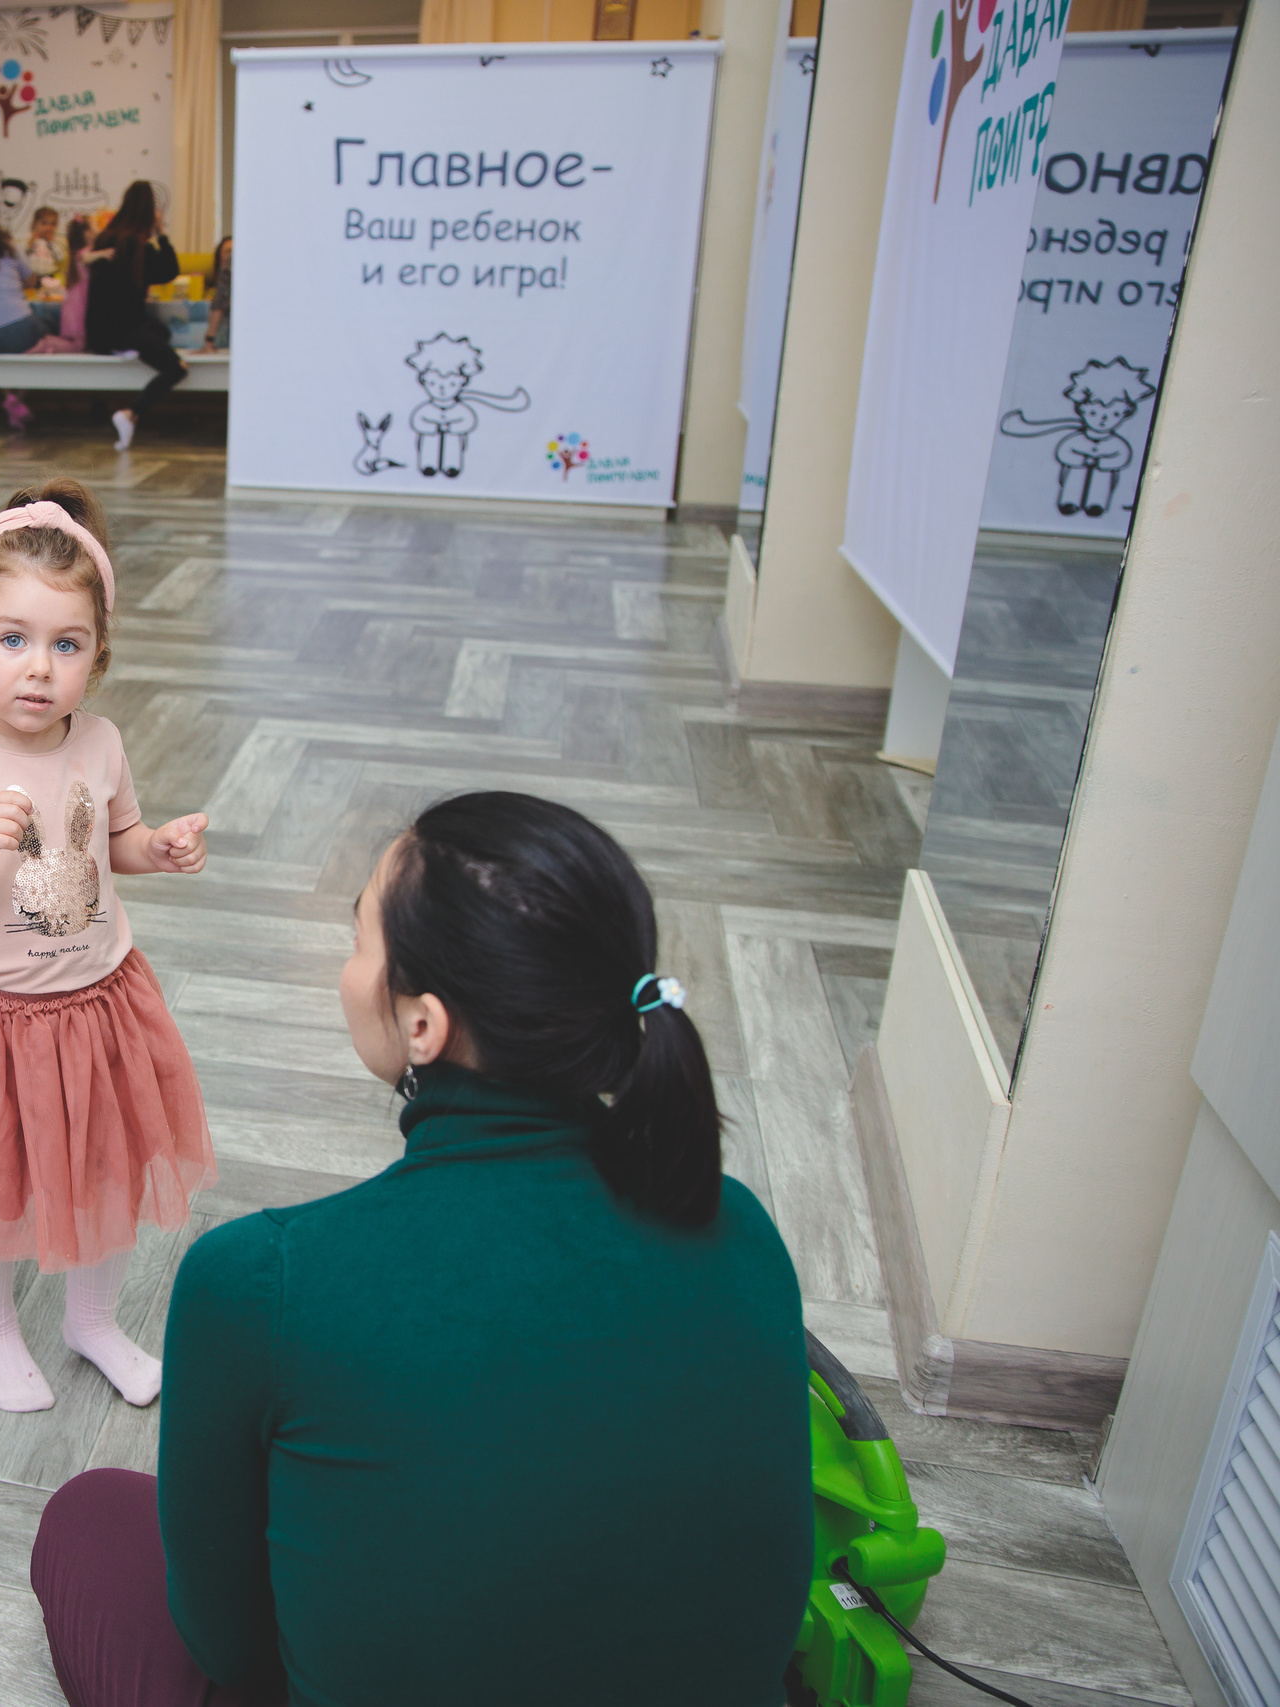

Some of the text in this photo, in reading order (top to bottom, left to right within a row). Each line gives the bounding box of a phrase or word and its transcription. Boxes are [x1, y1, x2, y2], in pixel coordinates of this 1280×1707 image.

[344, 208, 582, 251] Ваш ребенок
[361, 256, 568, 298] и его игра!
[28, 944, 90, 959] happy nature
